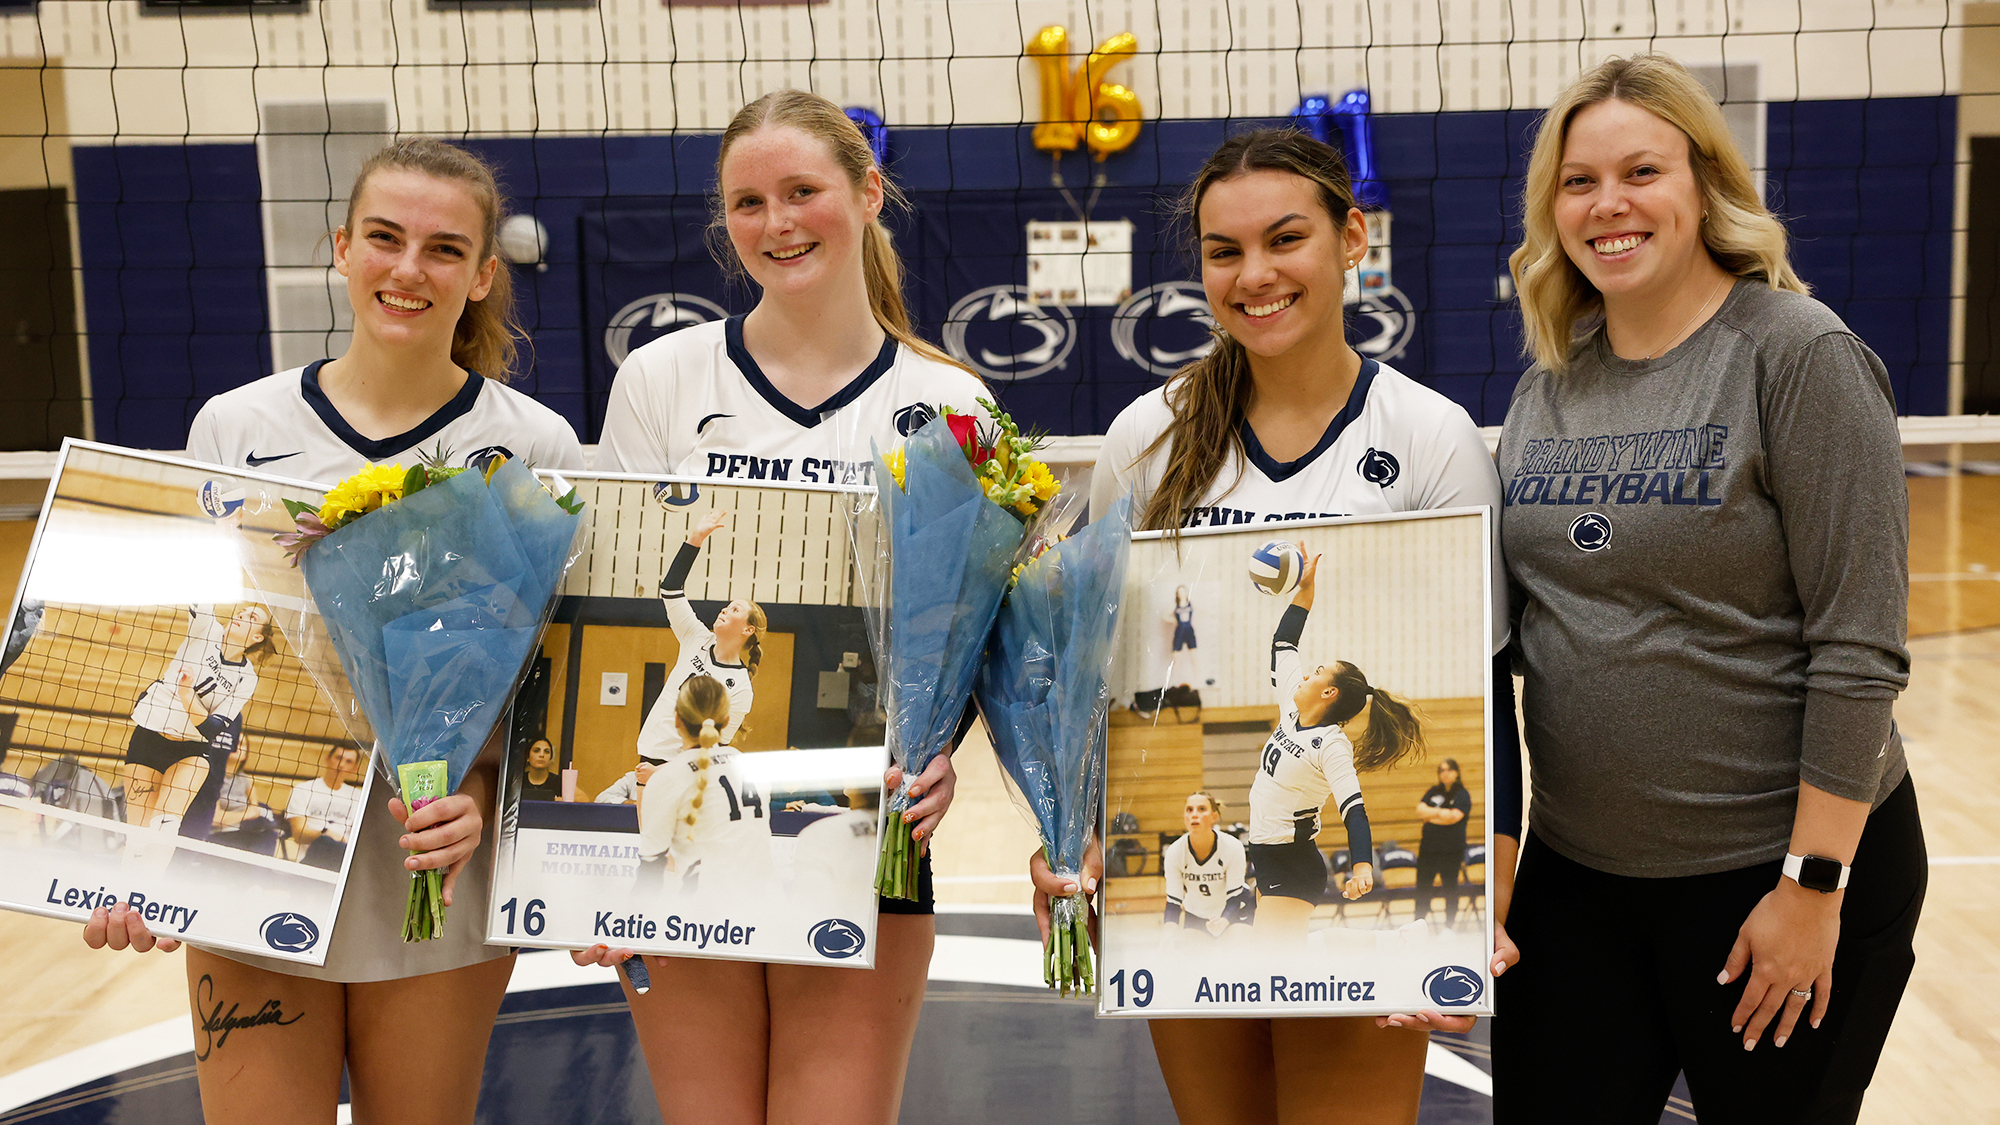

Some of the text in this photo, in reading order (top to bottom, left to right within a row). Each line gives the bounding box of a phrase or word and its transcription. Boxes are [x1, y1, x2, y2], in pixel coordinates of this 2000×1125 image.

[1026, 26, 1142, 152] 16
[1515, 423, 1728, 477] BRANDYWINE
[706, 452, 876, 486] PENN STAT
[1505, 472, 1722, 507] VOLLEYBALL
[1181, 507, 1256, 528] ENN
[193, 676, 218, 699] 11
[1263, 743, 1282, 778] 19
[719, 772, 763, 822] 14
[540, 861, 636, 878] MOLINAR
[46, 878, 198, 933] Lexie Berry
[1199, 884, 1211, 896] 9
[500, 897, 546, 936] 16
[593, 911, 755, 949] Katie Snyder
[1109, 968, 1154, 1007] 19
[1194, 975, 1375, 1003] Anna Ramirez
